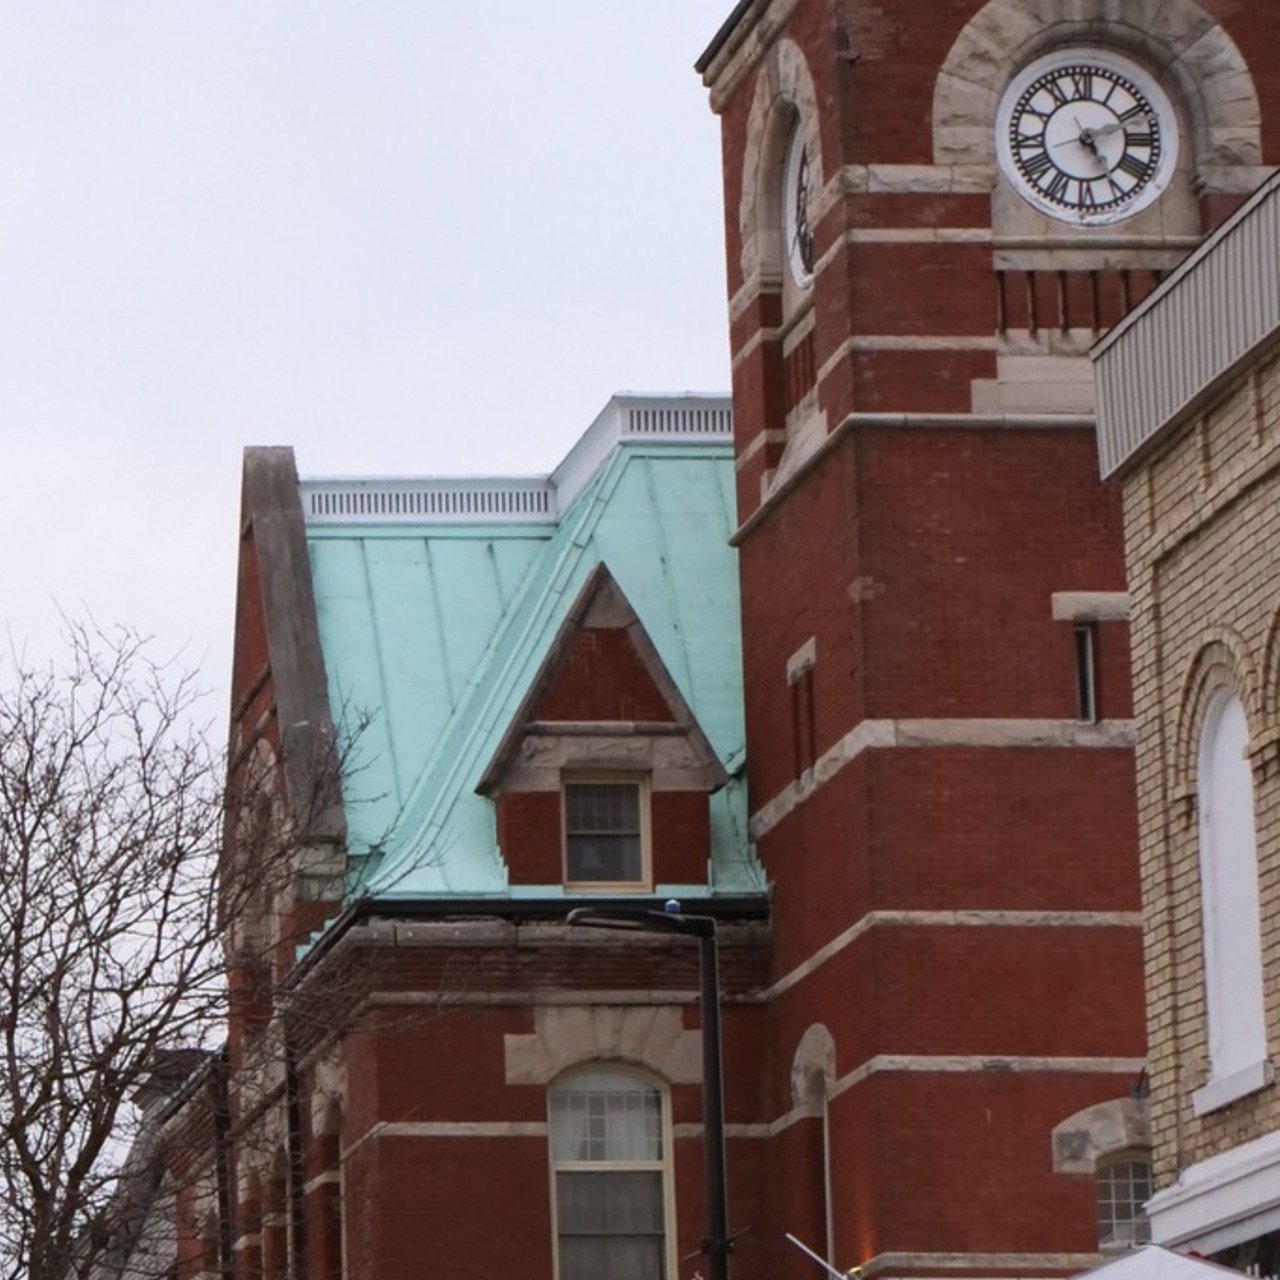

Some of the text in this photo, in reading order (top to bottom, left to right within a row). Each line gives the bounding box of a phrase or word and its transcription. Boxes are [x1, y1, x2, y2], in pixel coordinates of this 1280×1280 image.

[1071, 74, 1093, 101] XII
[1119, 100, 1146, 122] II
[1126, 132, 1153, 147] III
[1078, 180, 1096, 206] VI
